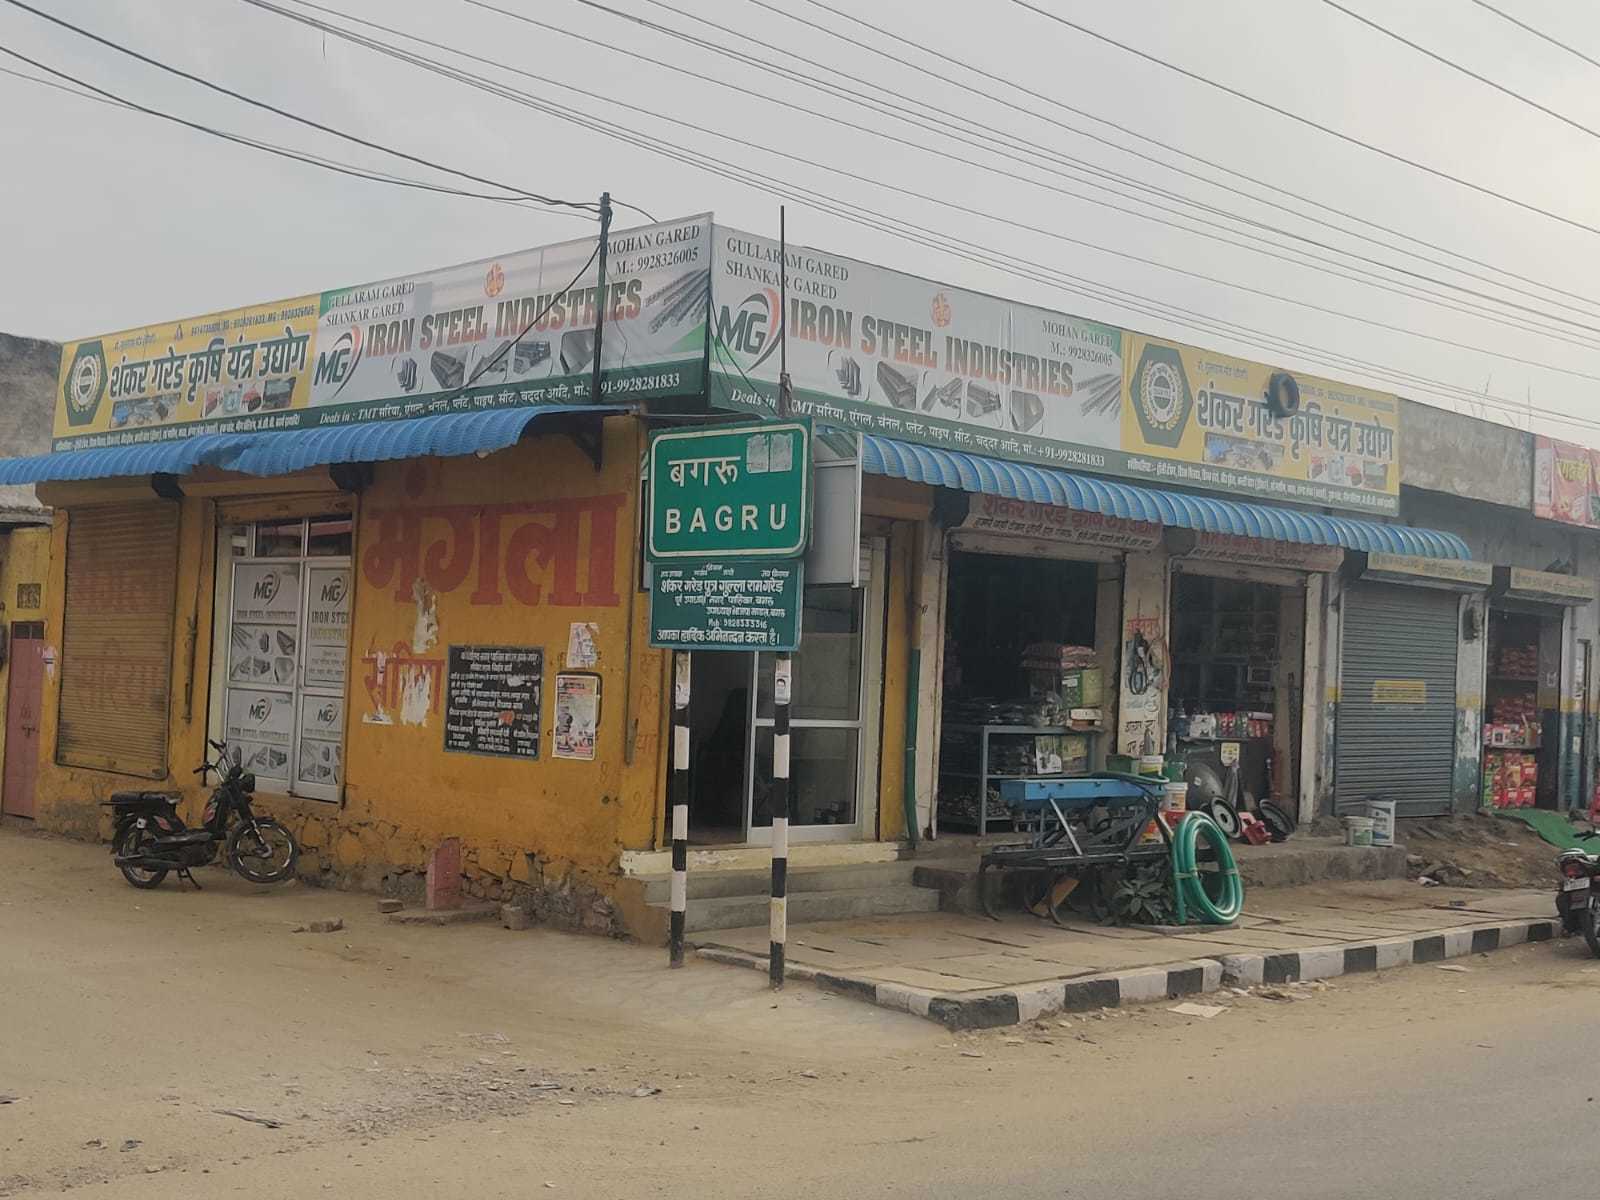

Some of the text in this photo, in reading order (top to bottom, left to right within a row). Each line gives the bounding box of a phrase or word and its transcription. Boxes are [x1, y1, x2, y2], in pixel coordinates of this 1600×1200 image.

[608, 225, 700, 255] MOHAN GARED
[637, 247, 698, 271] 9928326005
[727, 238, 849, 281] GULLARAM GARED
[382, 281, 415, 300] GARED
[726, 260, 837, 300] SHANKAR GARED
[327, 302, 405, 327] SHANKAR GARED
[366, 279, 642, 358] IRON STEEL INDUSTRIES
[718, 305, 767, 354] MG
[1043, 320, 1078, 340] MOHAN
[790, 298, 1073, 397] IRON STEEL INDUSTRIES
[110, 327, 311, 402] शंकर गरेड कृषि यंत्र उद्योग
[313, 347, 351, 386] MG
[320, 413, 340, 425] Deals
[1196, 381, 1245, 432] शंकर
[668, 456, 741, 487] बगरू
[665, 503, 787, 534] BAGRU
[253, 582, 273, 600] MG
[321, 584, 341, 602] MG
[660, 578, 683, 593] शंकर
[704, 579, 718, 597] पुत्र
[312, 611, 329, 624] IRON
[249, 704, 266, 720] MG
[317, 709, 333, 722] MG
